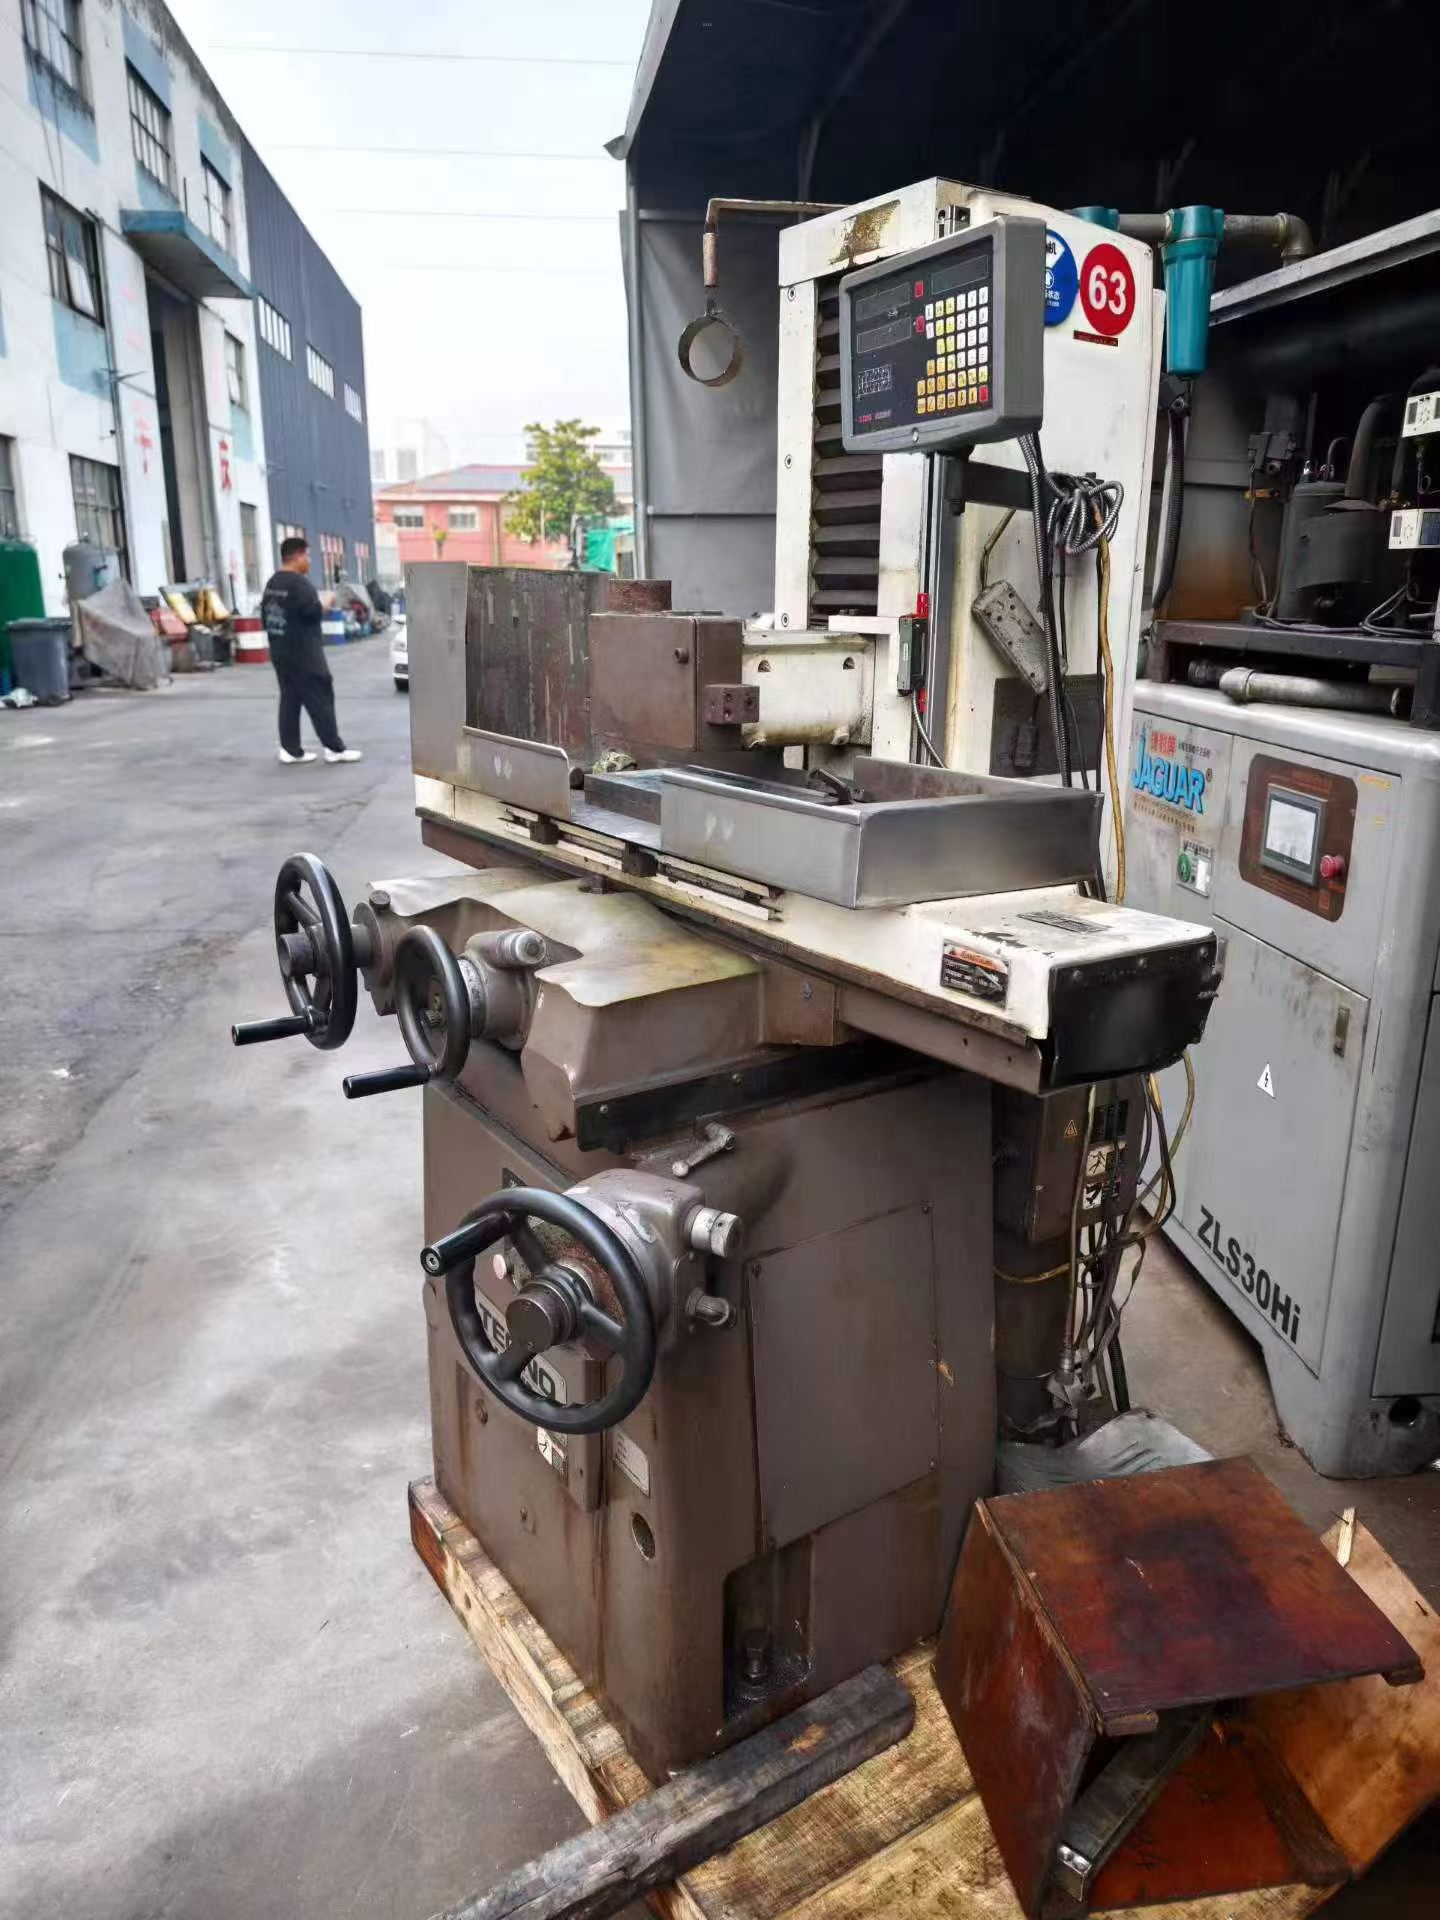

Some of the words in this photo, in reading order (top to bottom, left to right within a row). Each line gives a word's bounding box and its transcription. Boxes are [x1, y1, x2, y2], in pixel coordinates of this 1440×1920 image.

[1089, 264, 1127, 315] 63
[1131, 733, 1205, 814] JAGUAR
[1197, 1205, 1301, 1345] ZLS30Hi
